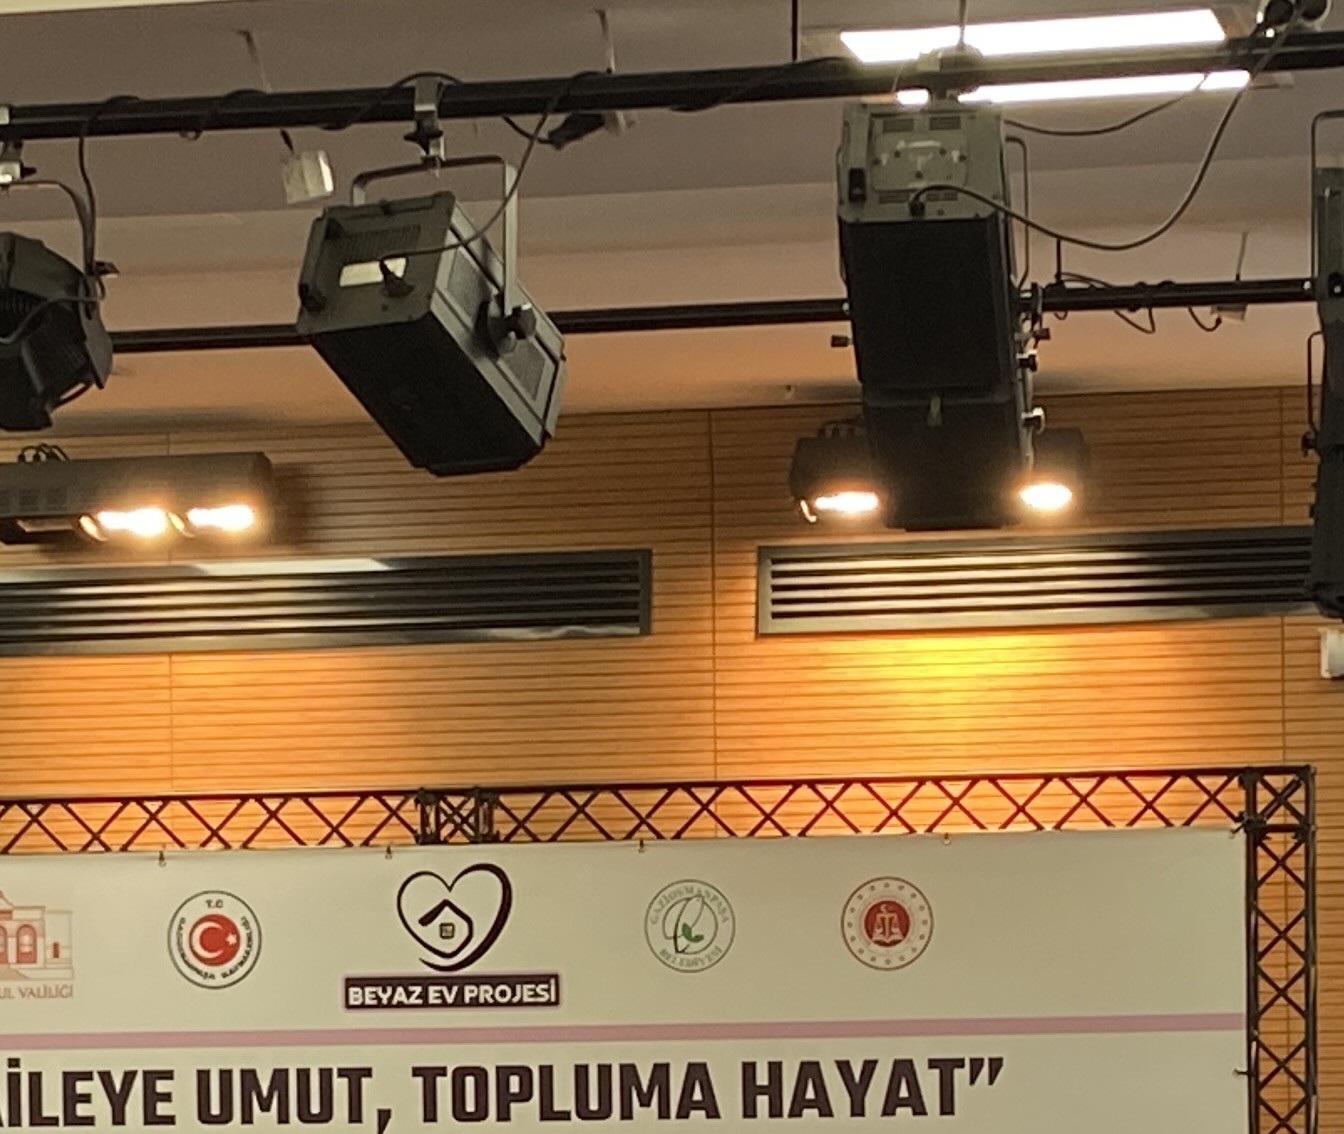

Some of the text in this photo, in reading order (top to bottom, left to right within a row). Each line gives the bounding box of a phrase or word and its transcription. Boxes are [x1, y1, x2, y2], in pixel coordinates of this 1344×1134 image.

[348, 977, 556, 1005] BEYAZ EV PROJESİ
[412, 1061, 721, 1122] TOPLUMA
[742, 1057, 1004, 1119] HAYAT”
